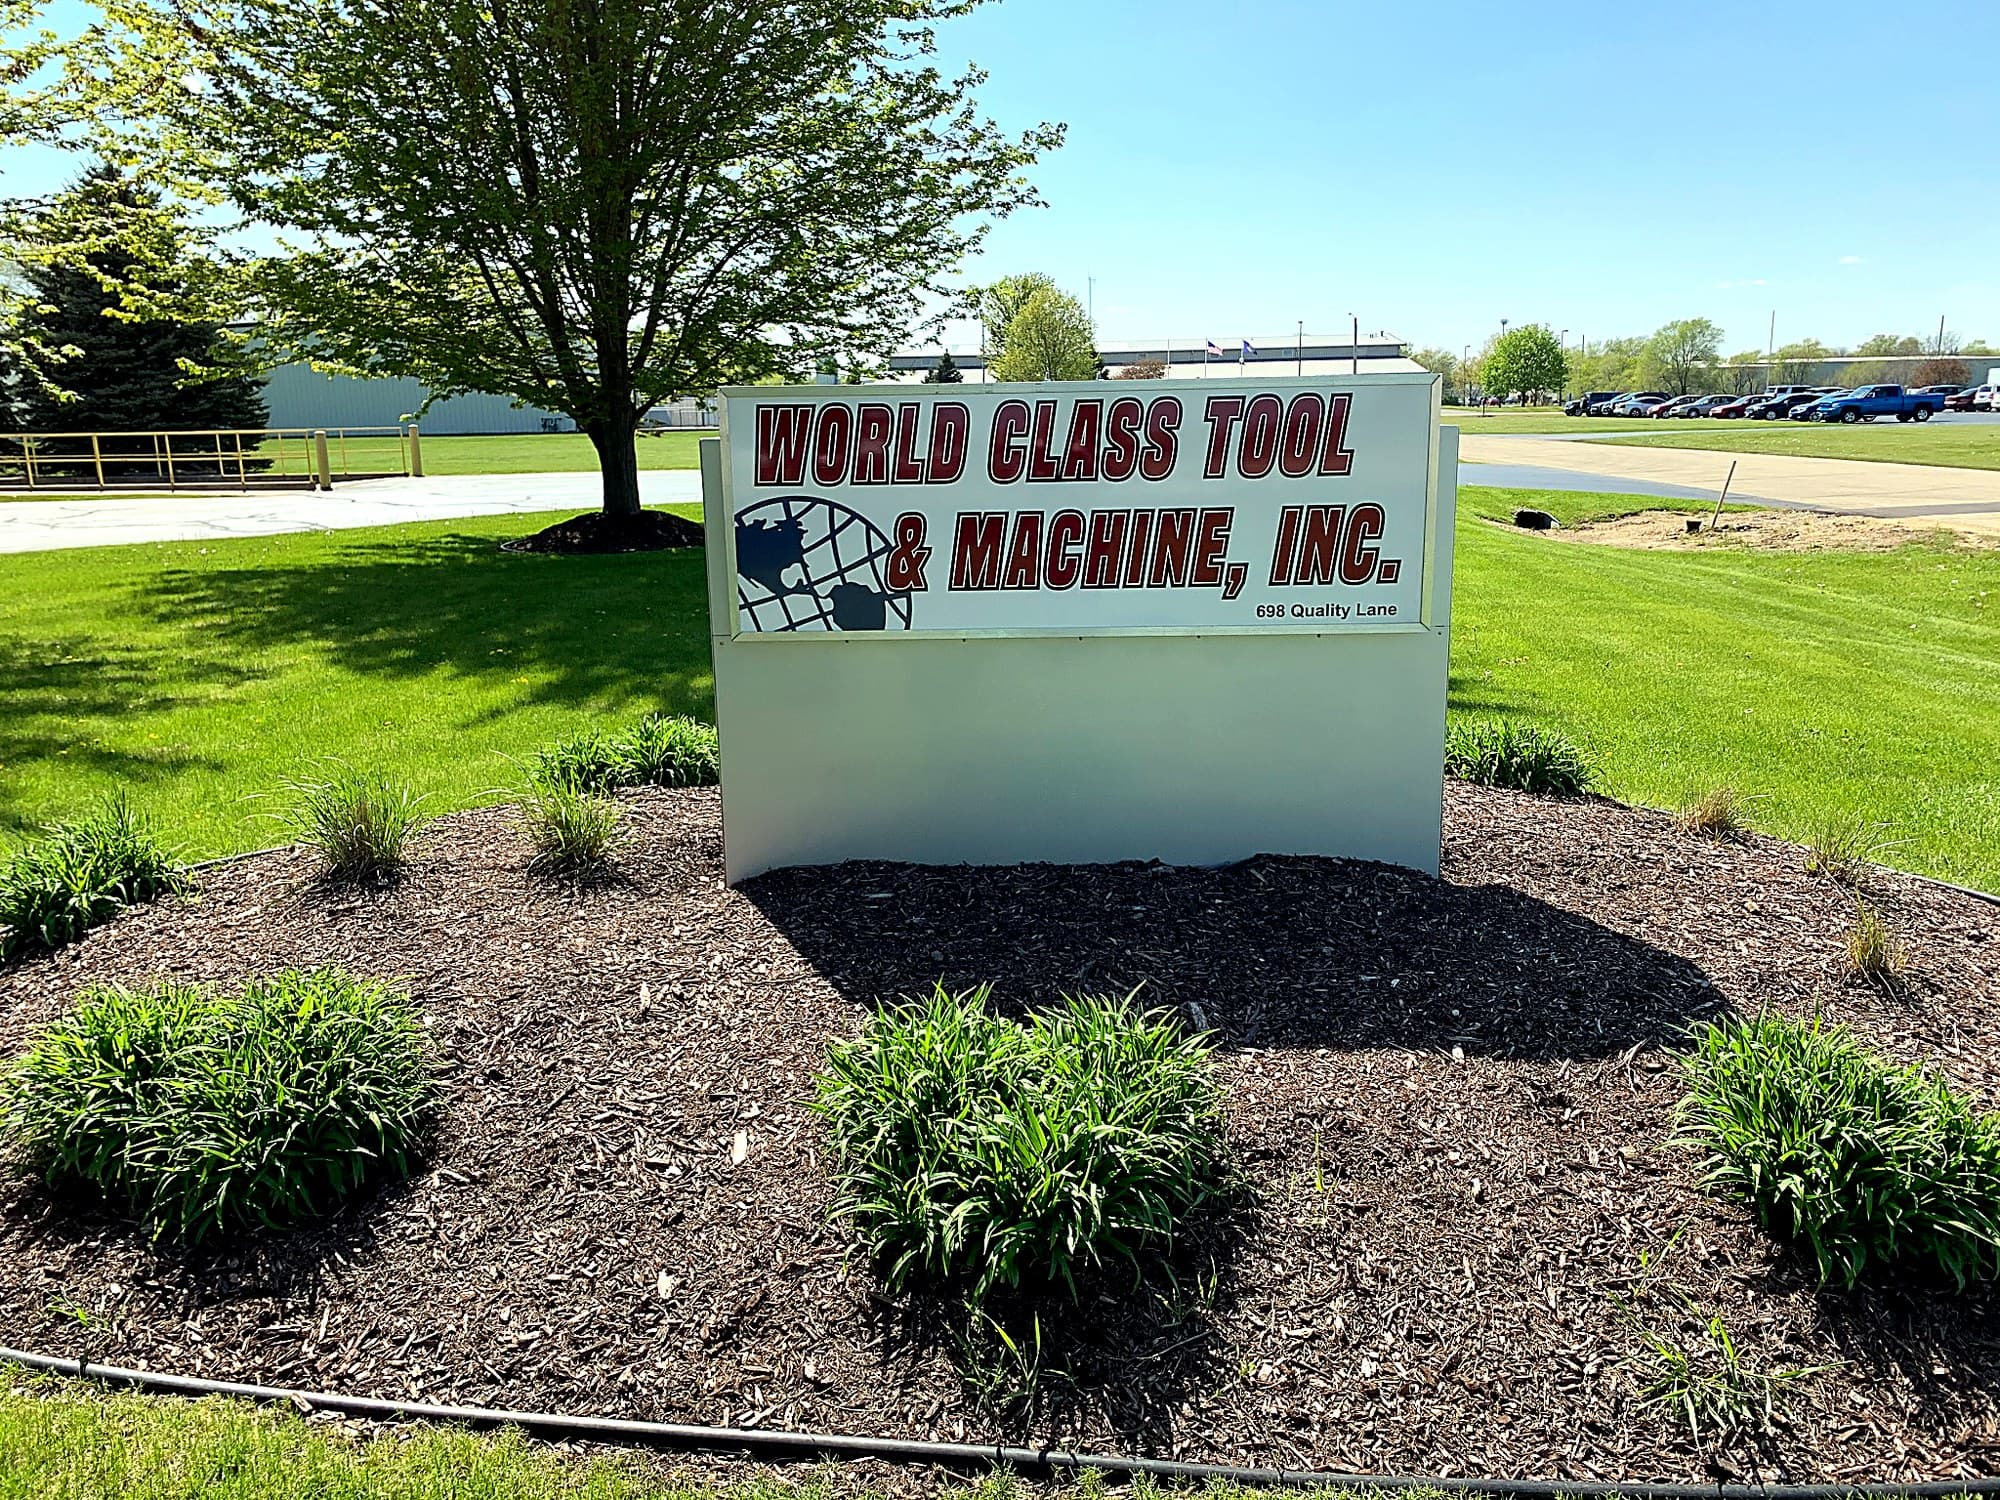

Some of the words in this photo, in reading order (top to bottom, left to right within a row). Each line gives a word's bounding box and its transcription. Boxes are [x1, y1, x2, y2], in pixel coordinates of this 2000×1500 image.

[754, 402, 972, 487] WORLD
[987, 395, 1182, 483] CLASS
[1203, 392, 1356, 480] TOOL
[886, 511, 931, 593] &
[948, 506, 1248, 601] MACHINE,
[1268, 502, 1402, 587] INC.
[1256, 604, 1285, 618] 698
[1290, 604, 1350, 619] Quality
[1356, 603, 1397, 616] Lane
